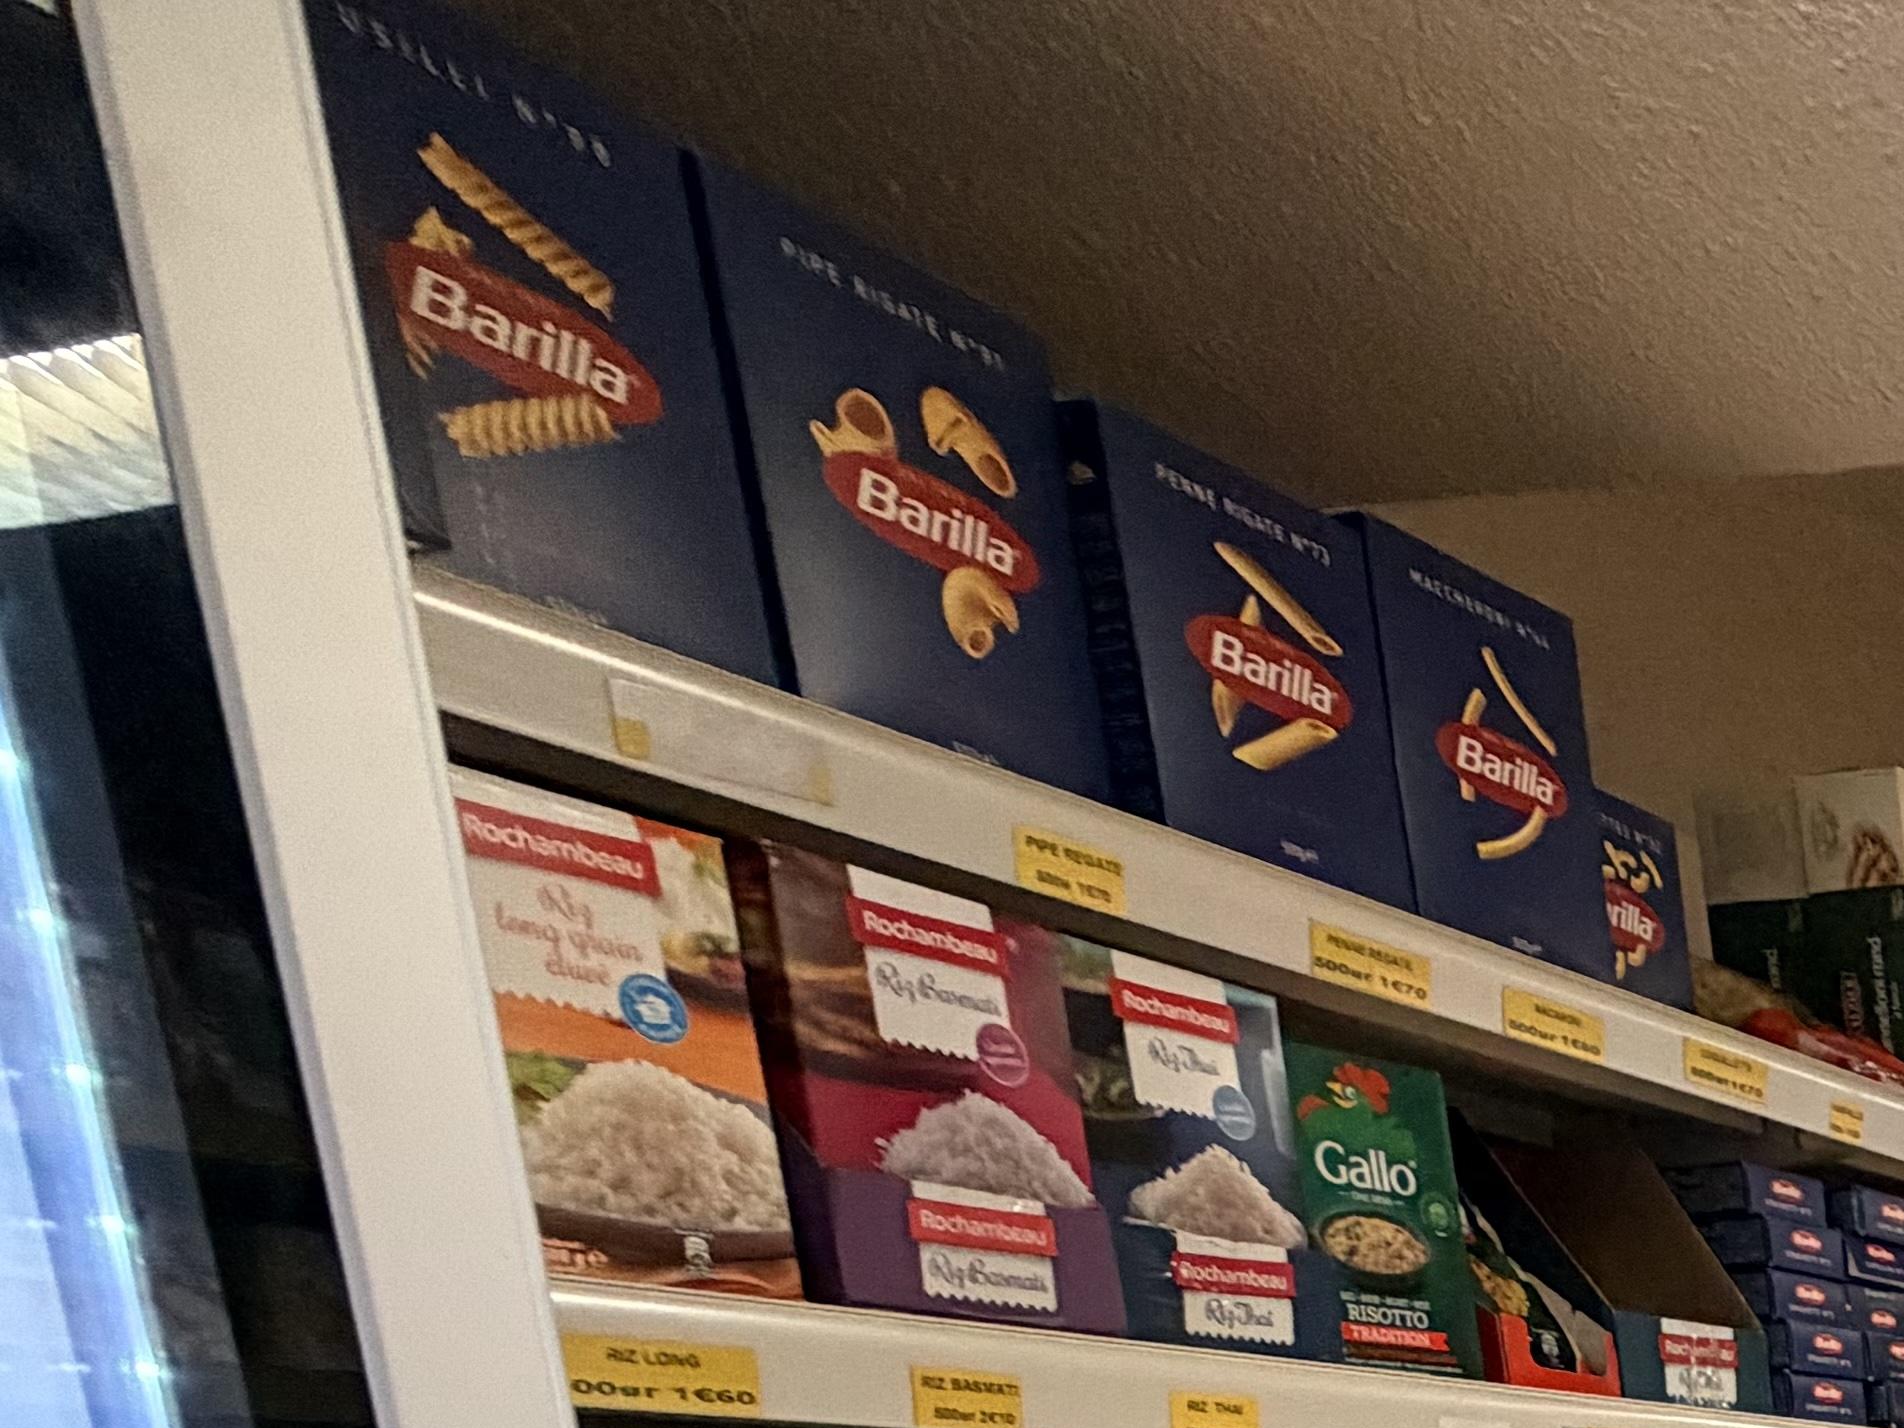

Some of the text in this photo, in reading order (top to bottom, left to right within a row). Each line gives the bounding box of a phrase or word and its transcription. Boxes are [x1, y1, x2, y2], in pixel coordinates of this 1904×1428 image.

[409, 264, 630, 405] Barilla
[854, 466, 1017, 577] Barilla
[1210, 629, 1338, 717] Barilla
[1455, 734, 1557, 806] Barilla
[463, 814, 645, 880] Rochambeau
[863, 909, 998, 964] Rochambeau
[1121, 989, 1230, 1036] Rochambeau
[1313, 1140, 1416, 1197] Gallo
[919, 1210, 1047, 1248] Rochambeau
[1180, 1264, 1287, 1290] Rochambeau
[1347, 1303, 1429, 1330] RISOTTO
[606, 1346, 702, 1369] RIZ LONG
[672, 1384, 757, 1406] 1€60
[921, 1374, 947, 1393] RIZ
